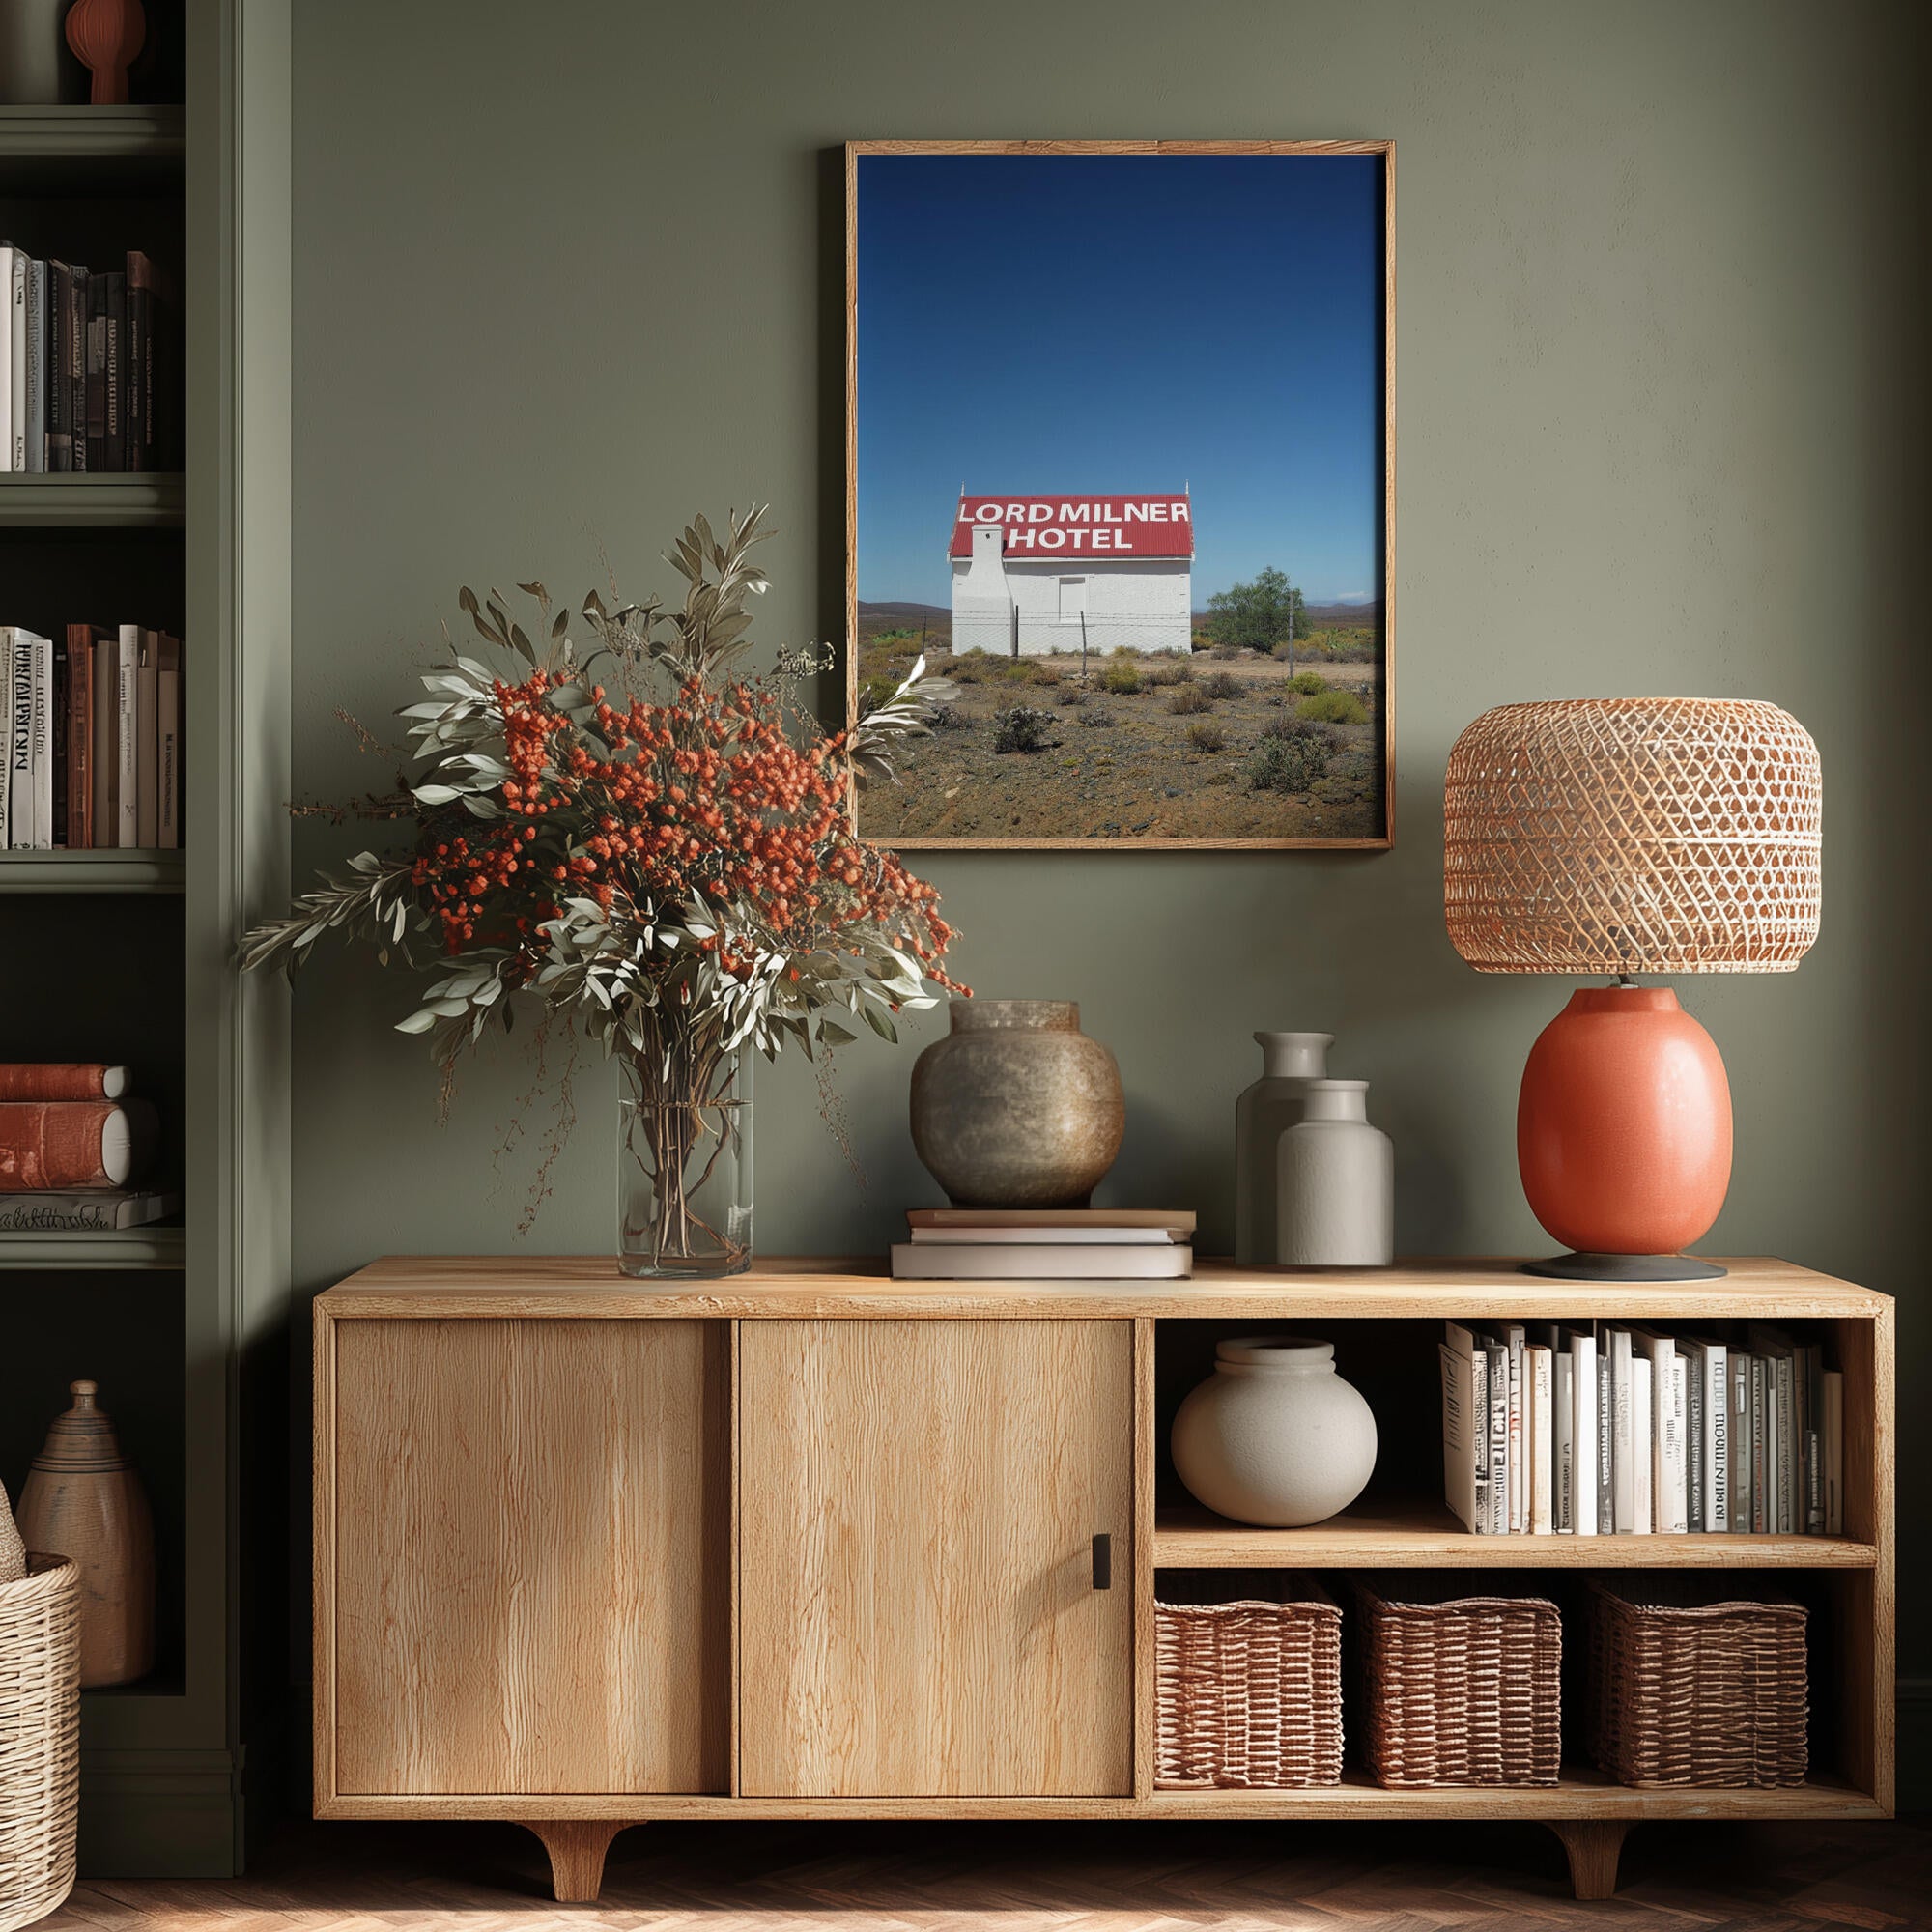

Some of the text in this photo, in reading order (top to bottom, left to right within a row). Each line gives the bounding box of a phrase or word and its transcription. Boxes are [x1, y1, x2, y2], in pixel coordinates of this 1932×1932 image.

[958, 503, 1189, 523] LORD MILNER
[1009, 528, 1133, 549] HOTEL
